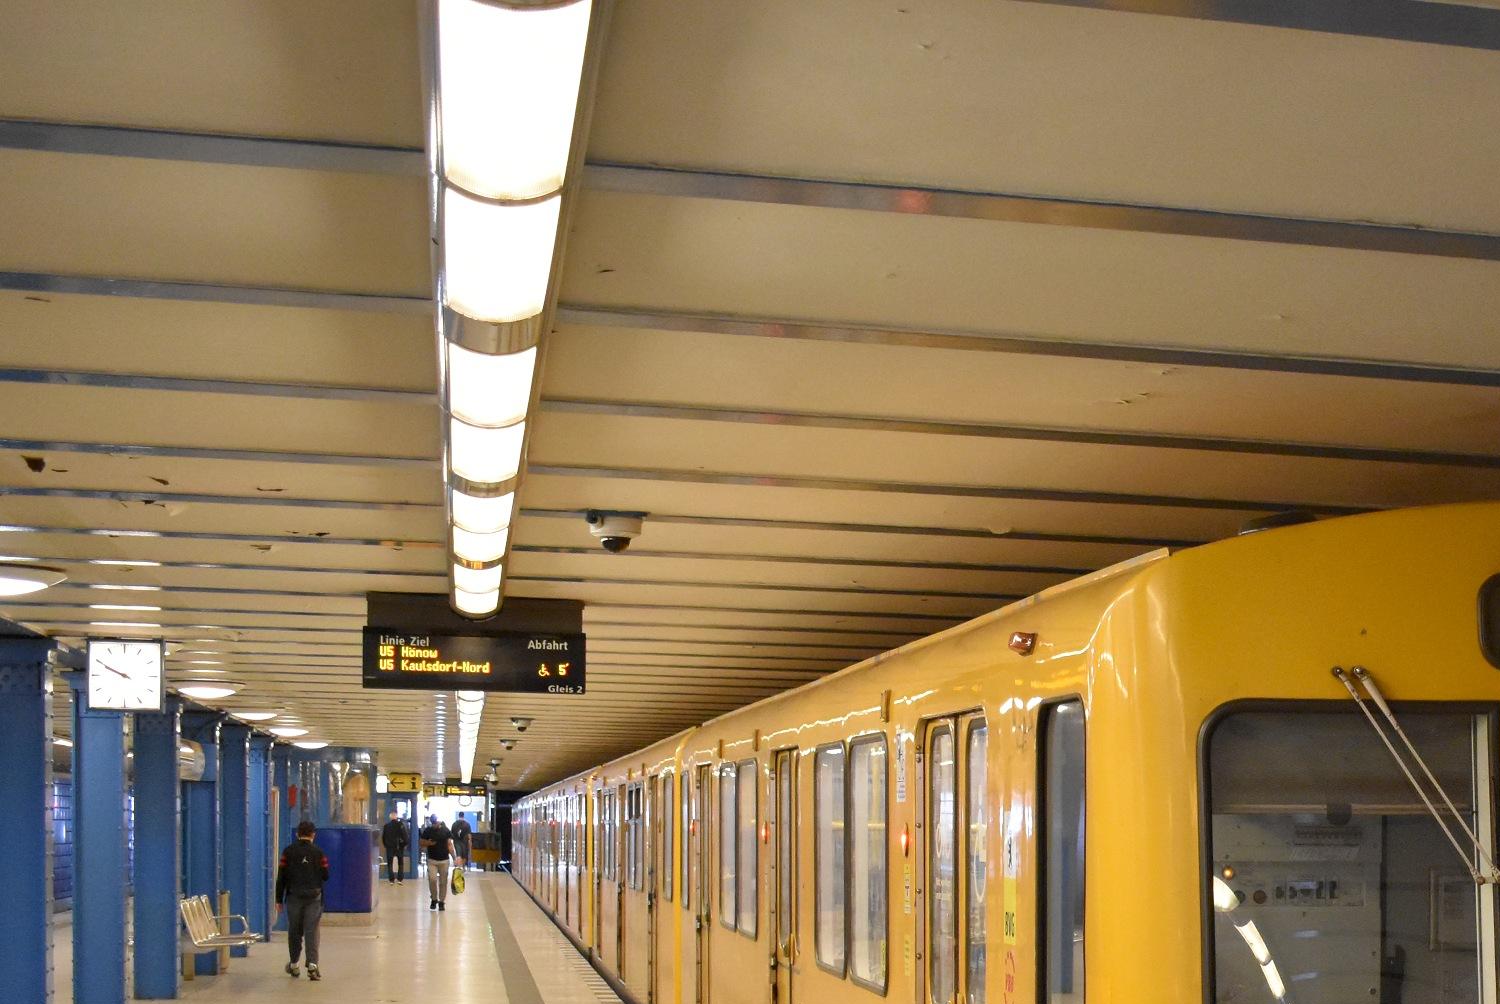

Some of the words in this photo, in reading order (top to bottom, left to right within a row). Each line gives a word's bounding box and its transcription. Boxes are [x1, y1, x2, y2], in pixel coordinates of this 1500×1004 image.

[380, 635, 405, 646] Linie
[410, 636, 430, 647] Ziel
[527, 639, 569, 651] Abfahrt
[379, 646, 394, 657] U5
[401, 647, 438, 659] Hönow
[379, 659, 394, 671] U5
[401, 660, 490, 674] Kaulsdorf-Nord
[548, 685, 573, 693] Gleis
[576, 685, 583, 694] 2
